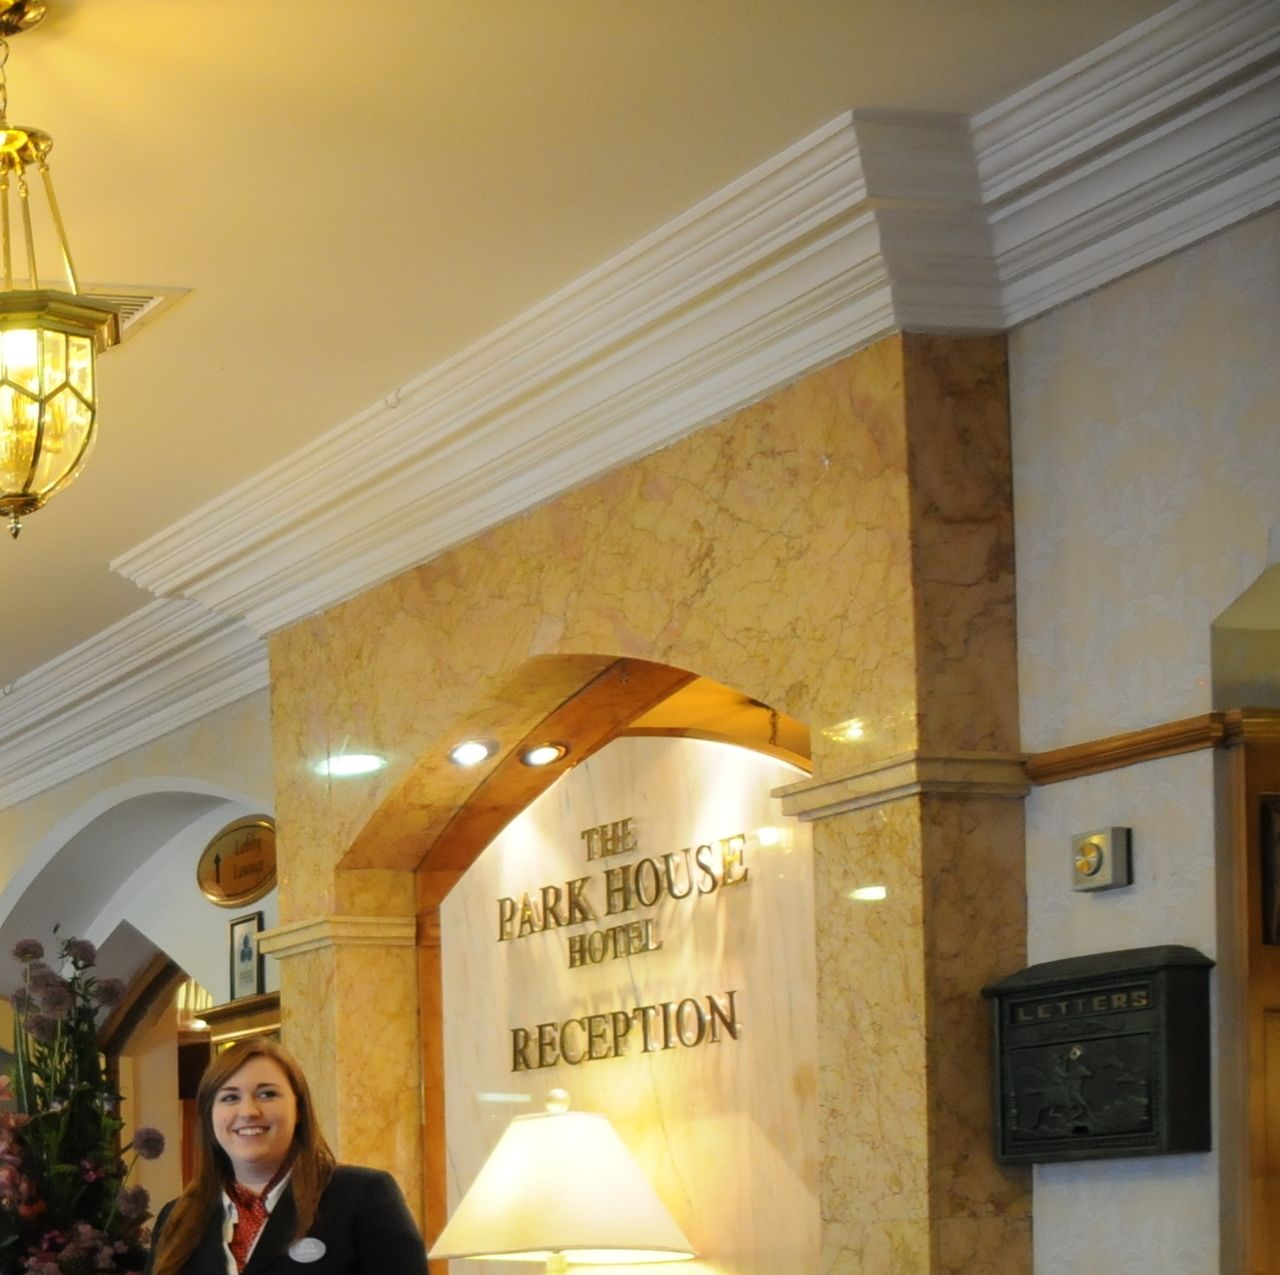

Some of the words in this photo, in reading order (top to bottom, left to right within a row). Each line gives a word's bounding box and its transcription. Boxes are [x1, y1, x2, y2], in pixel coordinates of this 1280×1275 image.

[581, 816, 638, 862] THE
[496, 875, 595, 943] PARK
[603, 833, 750, 917] HOUSE
[567, 917, 664, 970] HOTEL
[510, 990, 740, 1073] RECEPTION
[1017, 990, 1149, 1021] LETTERS
